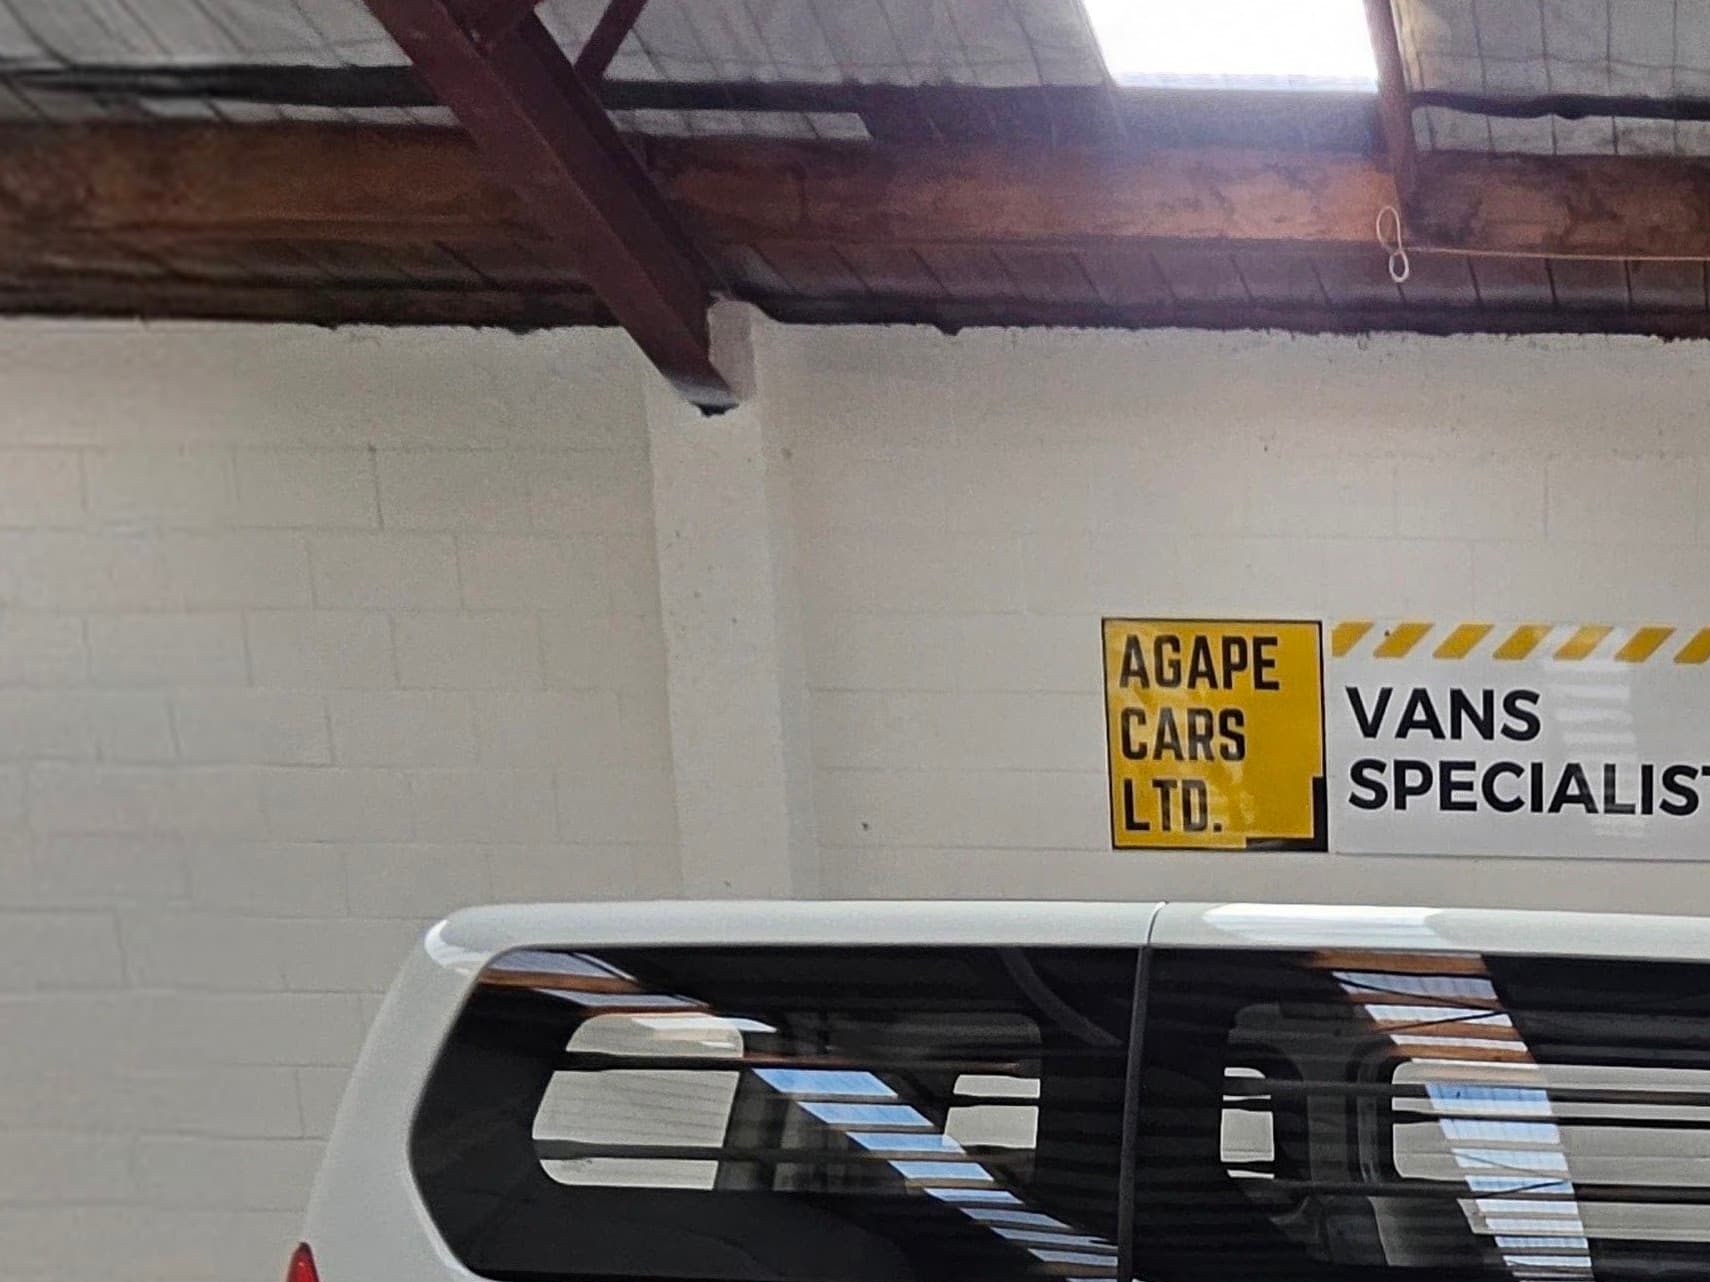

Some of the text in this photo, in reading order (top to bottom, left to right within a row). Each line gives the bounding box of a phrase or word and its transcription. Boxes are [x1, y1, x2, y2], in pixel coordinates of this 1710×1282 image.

[1119, 634, 1281, 692] AGAPE
[1120, 706, 1247, 763] CARS
[1345, 686, 1541, 742] VANS
[1122, 777, 1223, 834] LTD.
